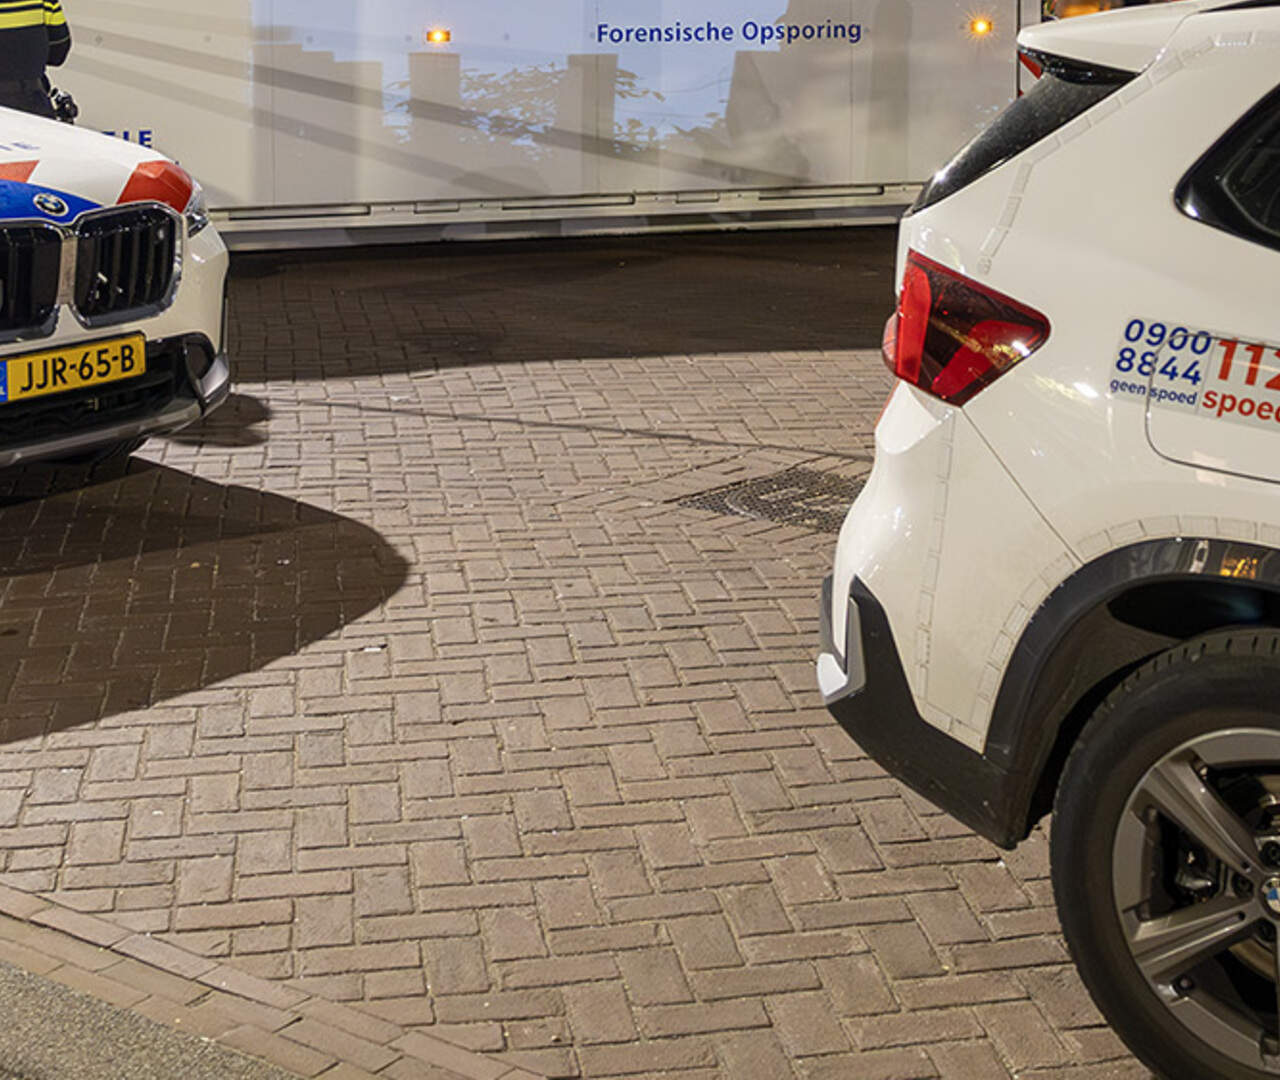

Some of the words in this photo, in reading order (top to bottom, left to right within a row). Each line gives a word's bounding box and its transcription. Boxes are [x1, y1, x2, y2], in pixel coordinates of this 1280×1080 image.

[597, 22, 734, 43] Forensische
[742, 20, 862, 44] Opsporing
[1124, 319, 1211, 355] 0900
[20, 344, 134, 392] JJR-65-B
[1115, 347, 1202, 386] 8844
[1110, 379, 1146, 396] geen
[1149, 387, 1197, 405] spoed
